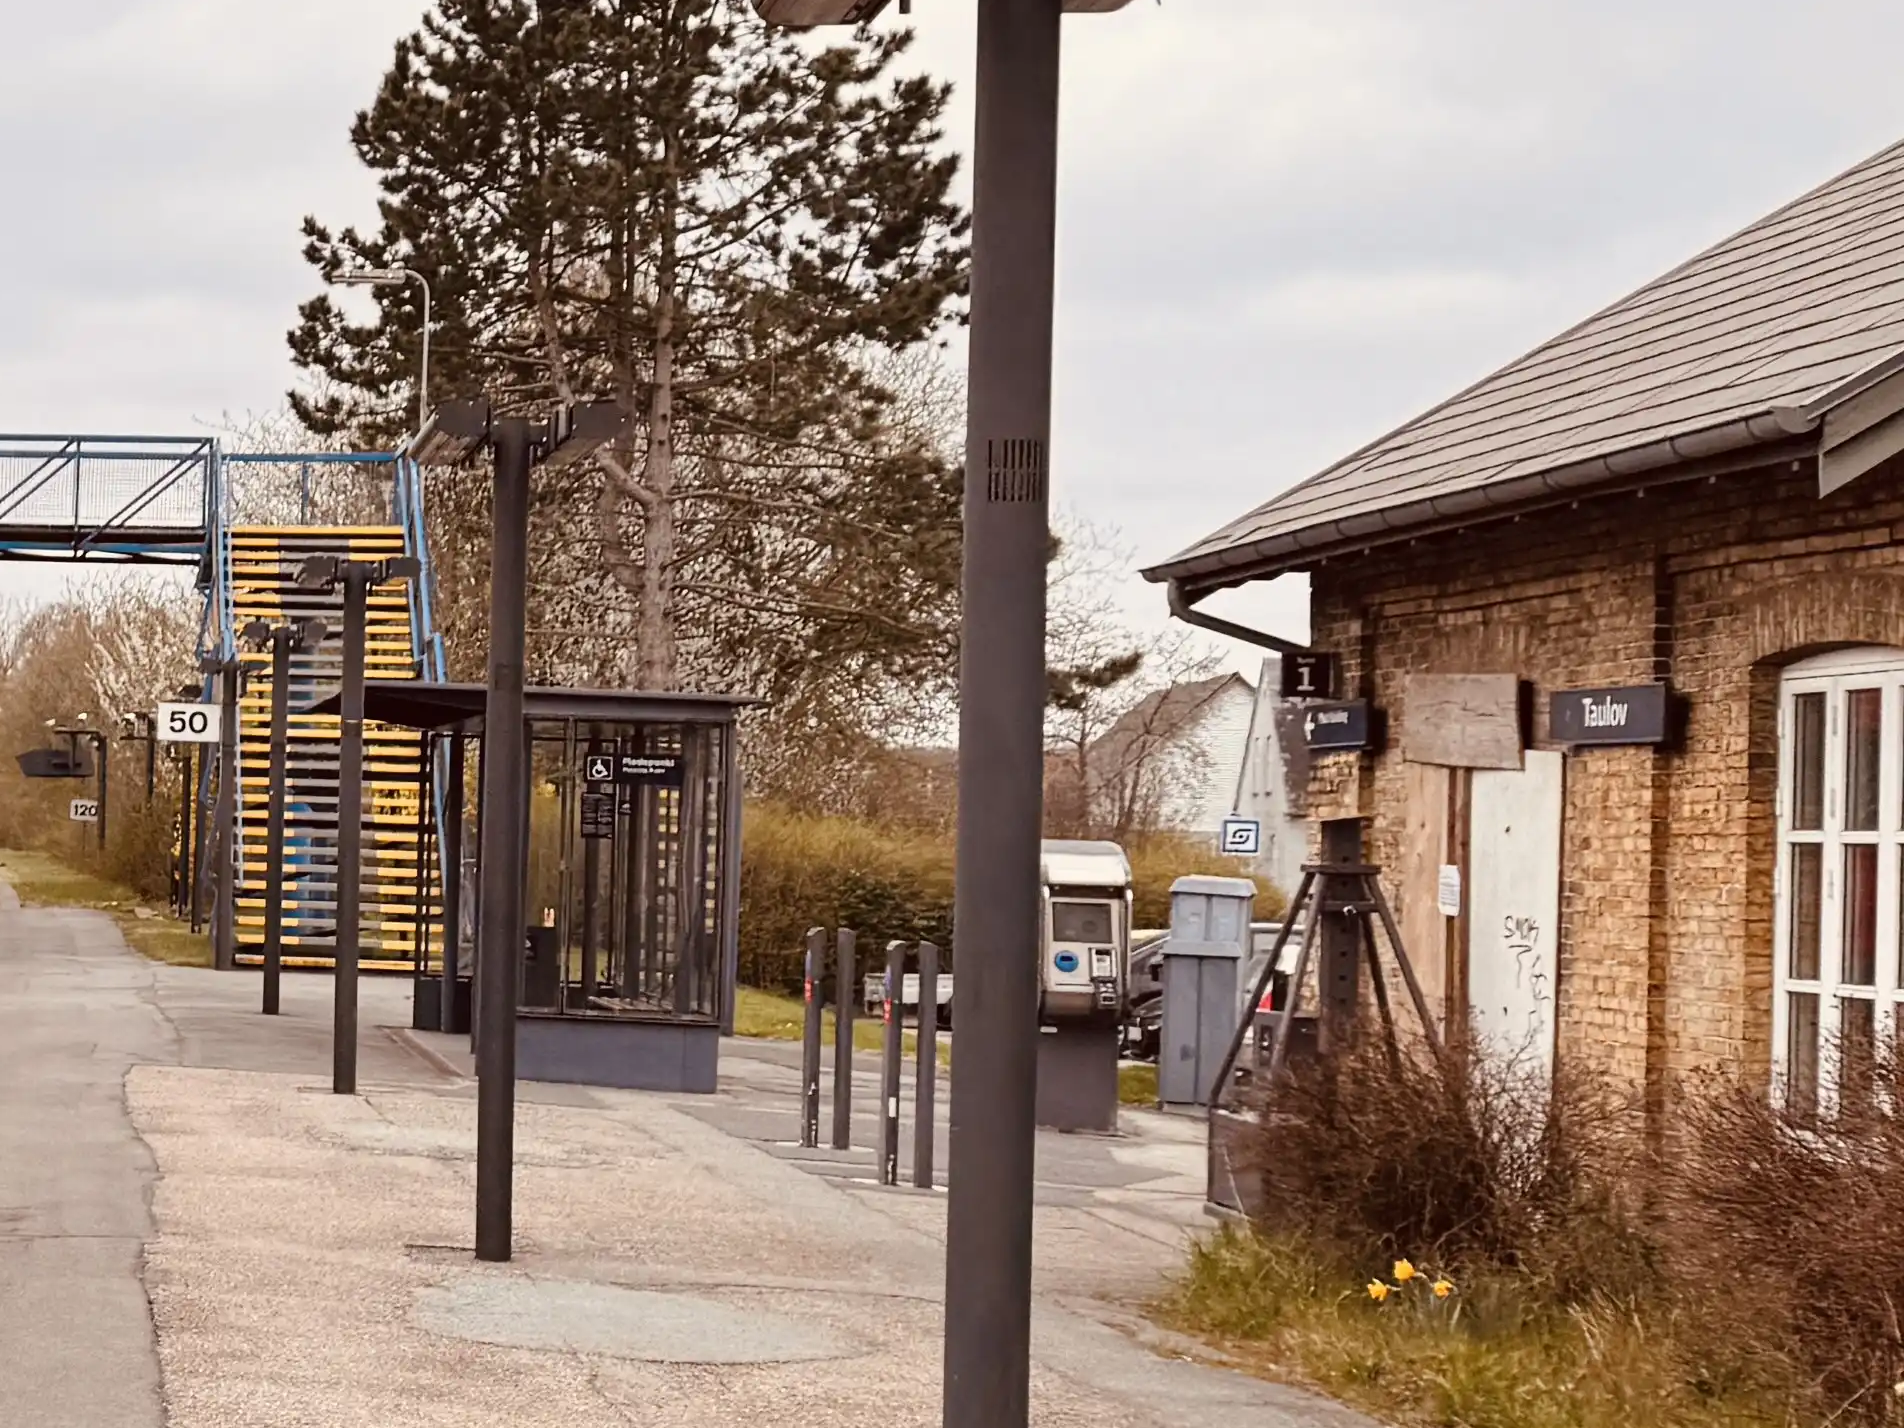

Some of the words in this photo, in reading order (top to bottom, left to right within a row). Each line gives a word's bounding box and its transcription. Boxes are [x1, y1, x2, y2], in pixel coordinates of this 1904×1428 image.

[1296, 667, 1315, 691] 1
[169, 711, 208, 734] 50
[1581, 695, 1628, 727] Taulov
[73, 803, 98, 817] 120
